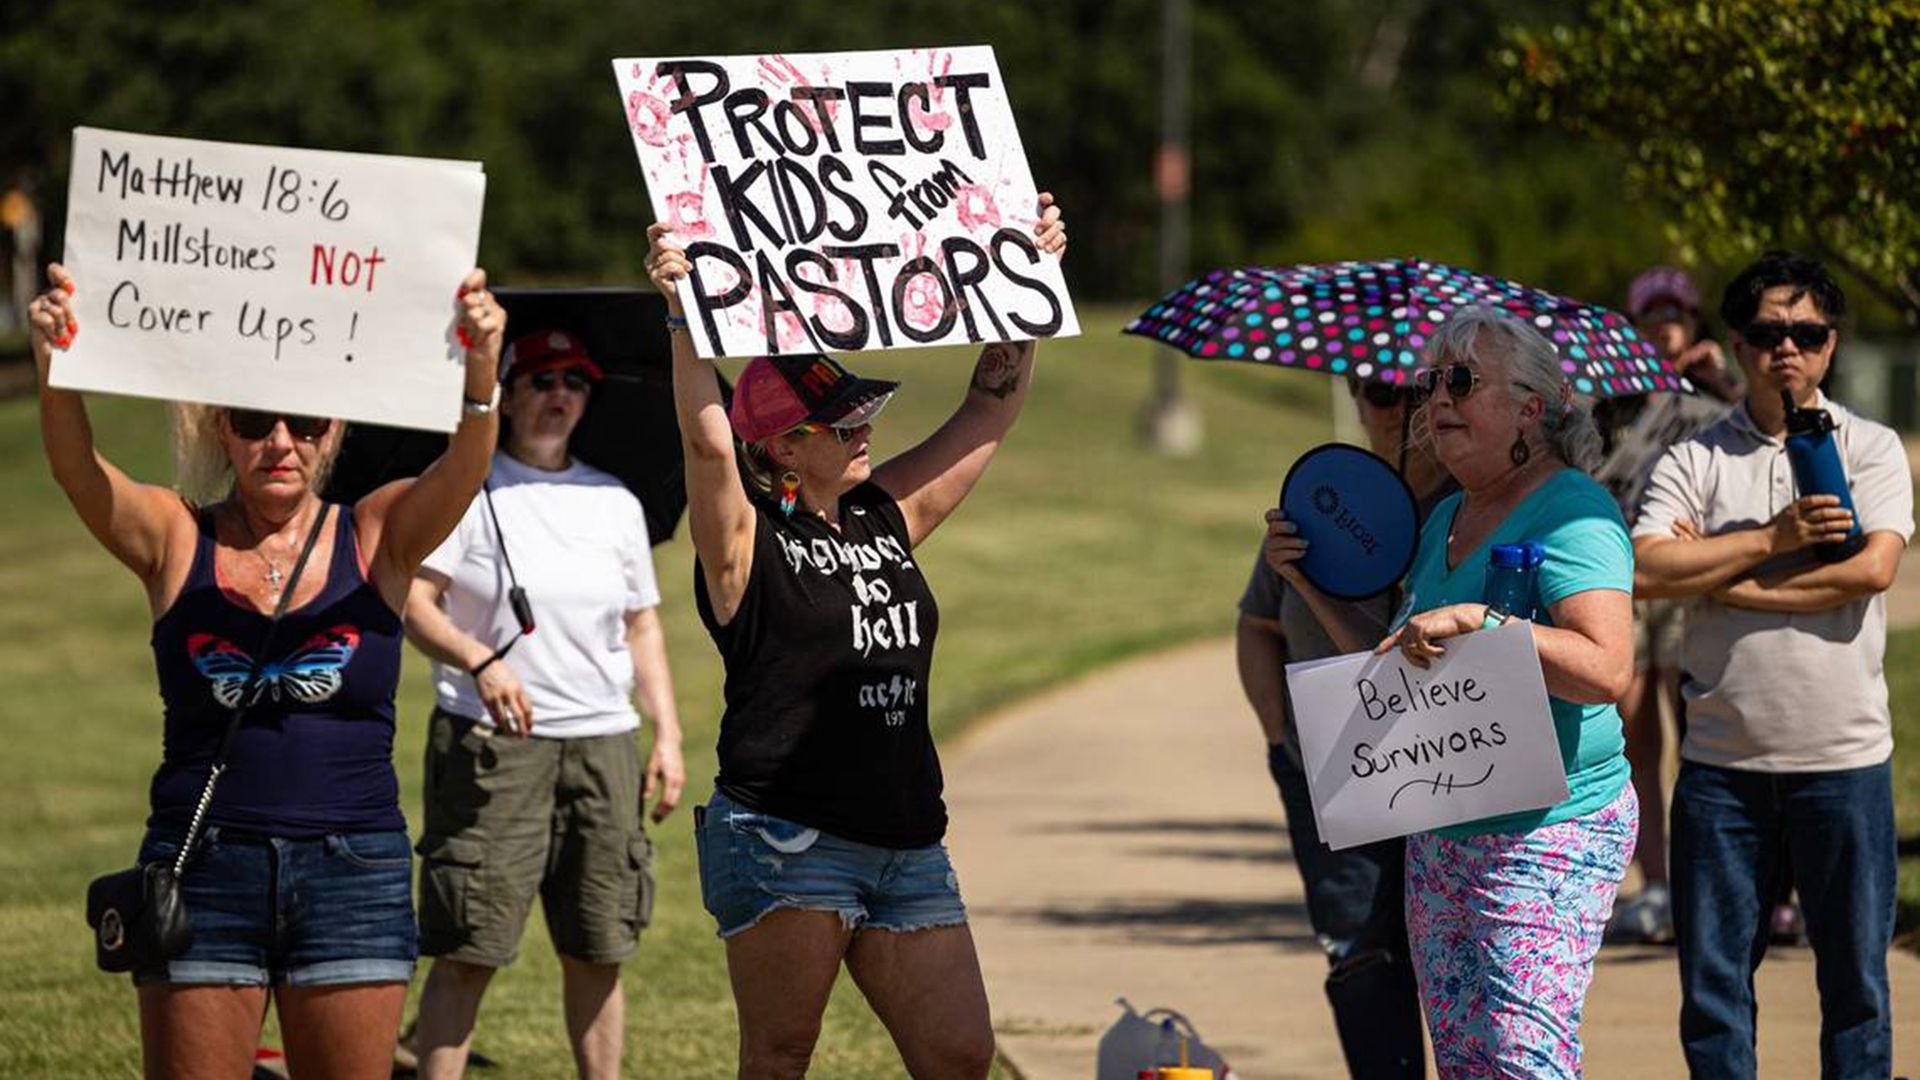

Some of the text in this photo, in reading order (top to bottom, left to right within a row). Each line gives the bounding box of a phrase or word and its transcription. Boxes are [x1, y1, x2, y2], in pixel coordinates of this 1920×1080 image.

[656, 60, 991, 164] PROTECT
[98, 149, 350, 221] Matthew 18:6
[710, 153, 975, 252] KIDS from
[116, 218, 277, 271] Millstones
[106, 281, 214, 333] Cover
[237, 301, 317, 360] Ups
[684, 227, 1064, 357] PASTORS
[852, 573, 892, 607] to
[851, 600, 920, 659] hell
[1356, 667, 1487, 722] Believe
